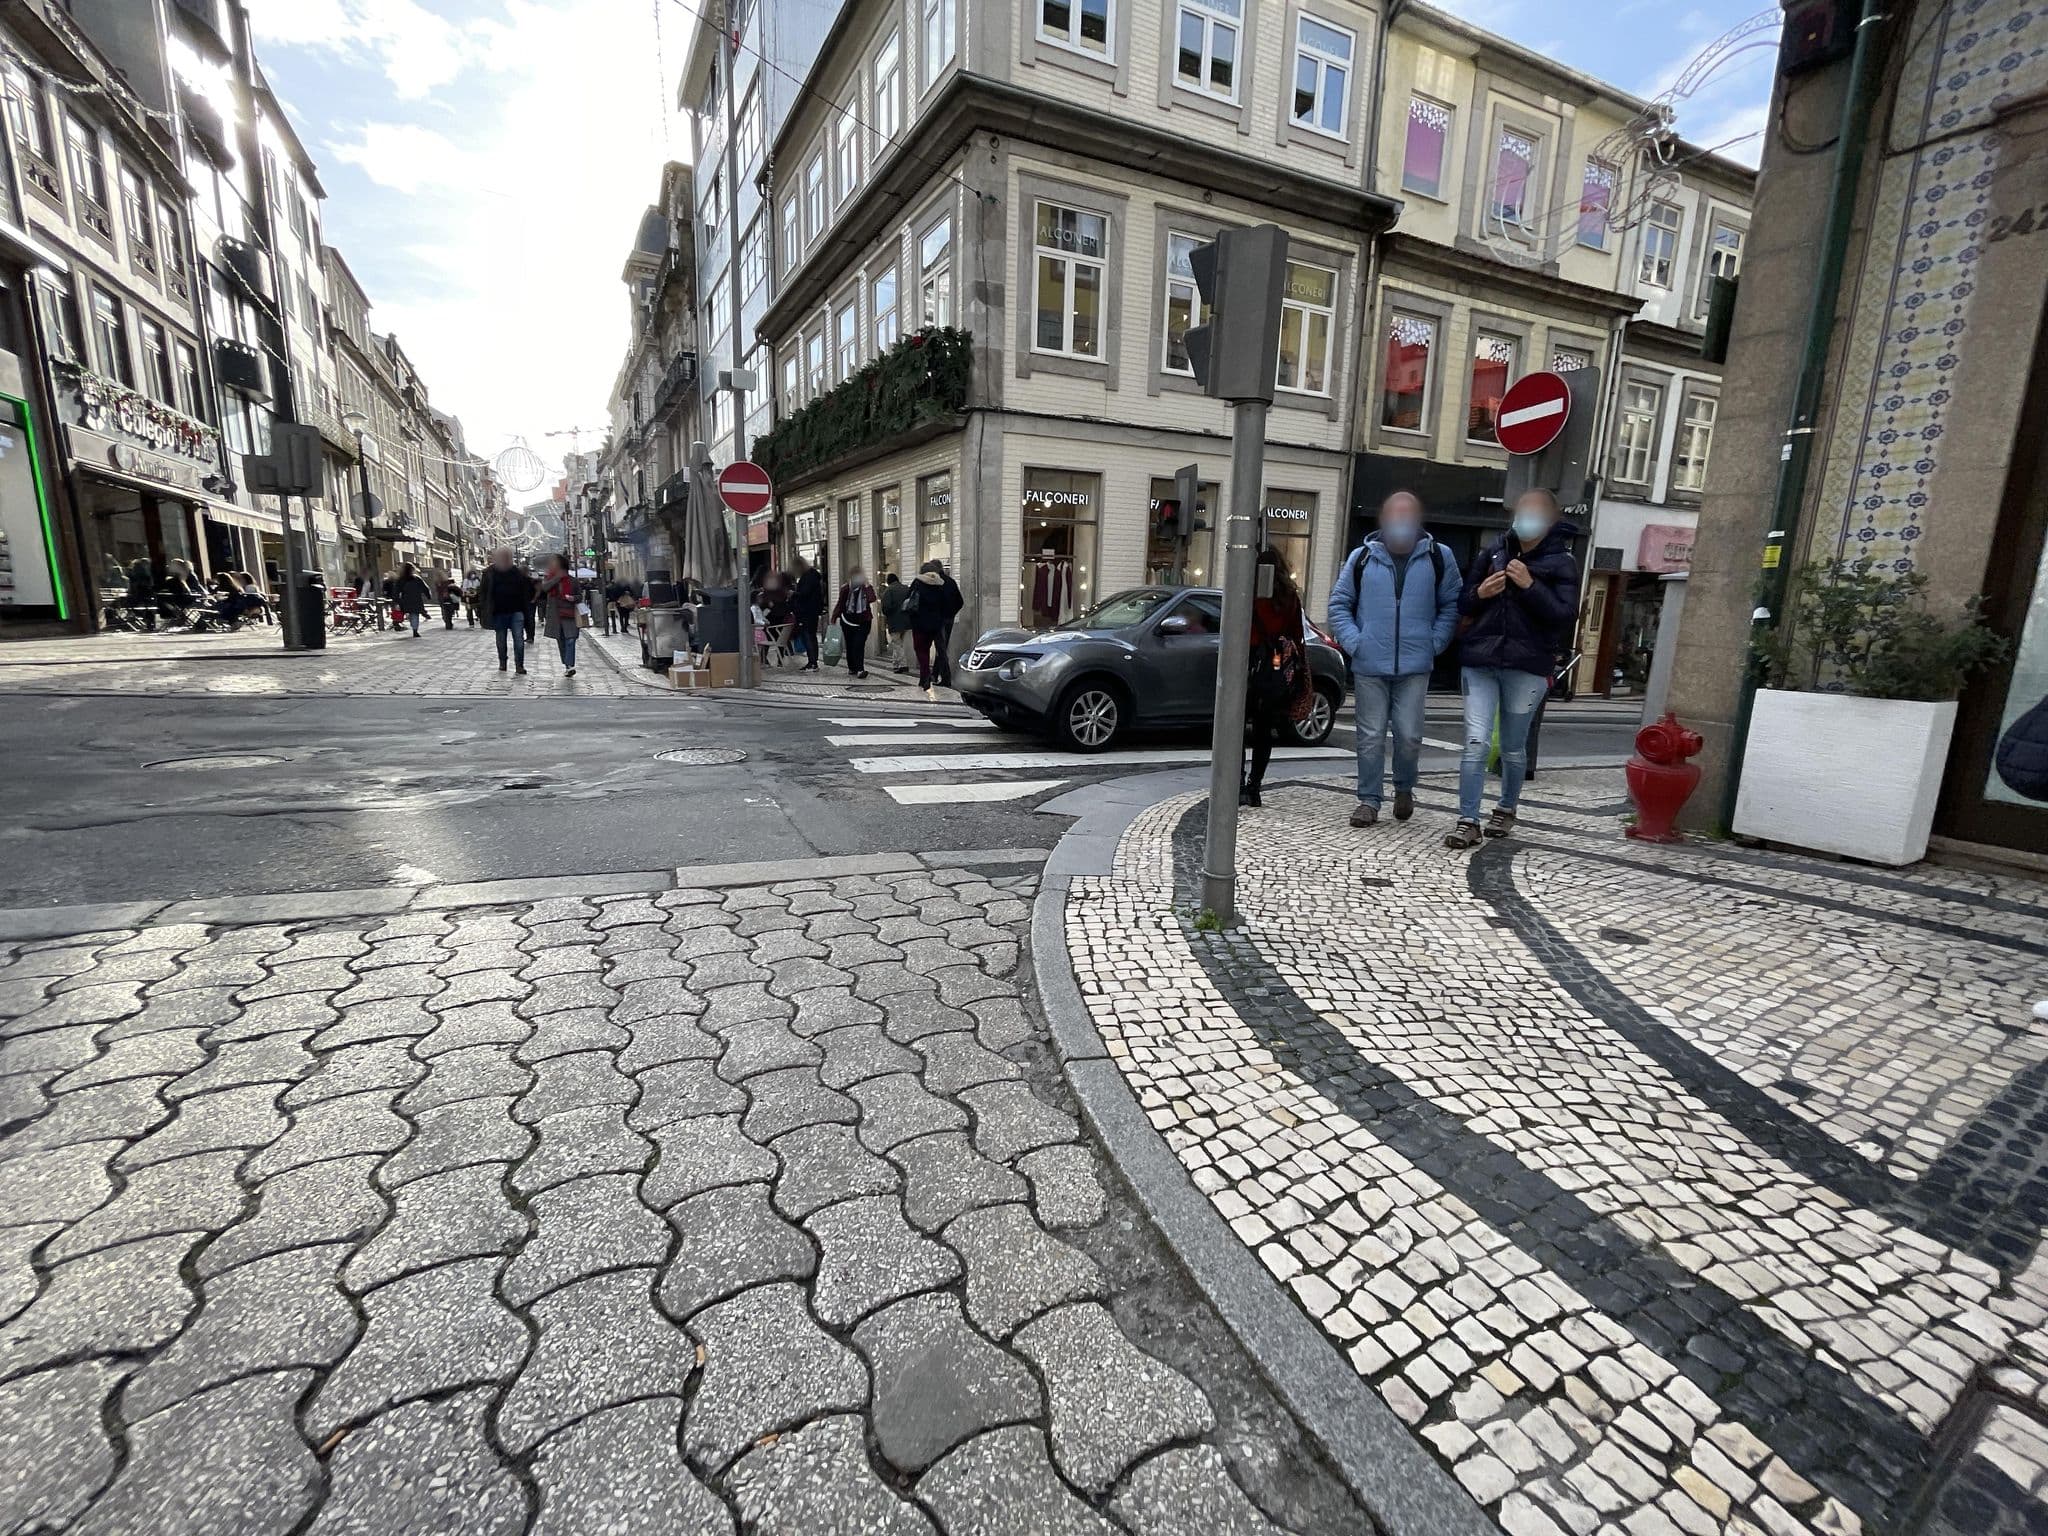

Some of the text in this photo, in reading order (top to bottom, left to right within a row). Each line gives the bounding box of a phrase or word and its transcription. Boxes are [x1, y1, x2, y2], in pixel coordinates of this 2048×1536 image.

[1039, 226, 1100, 248] ALCONERI
[1026, 490, 1089, 505] FALCONERI
[1267, 506, 1308, 520] LCONERI
